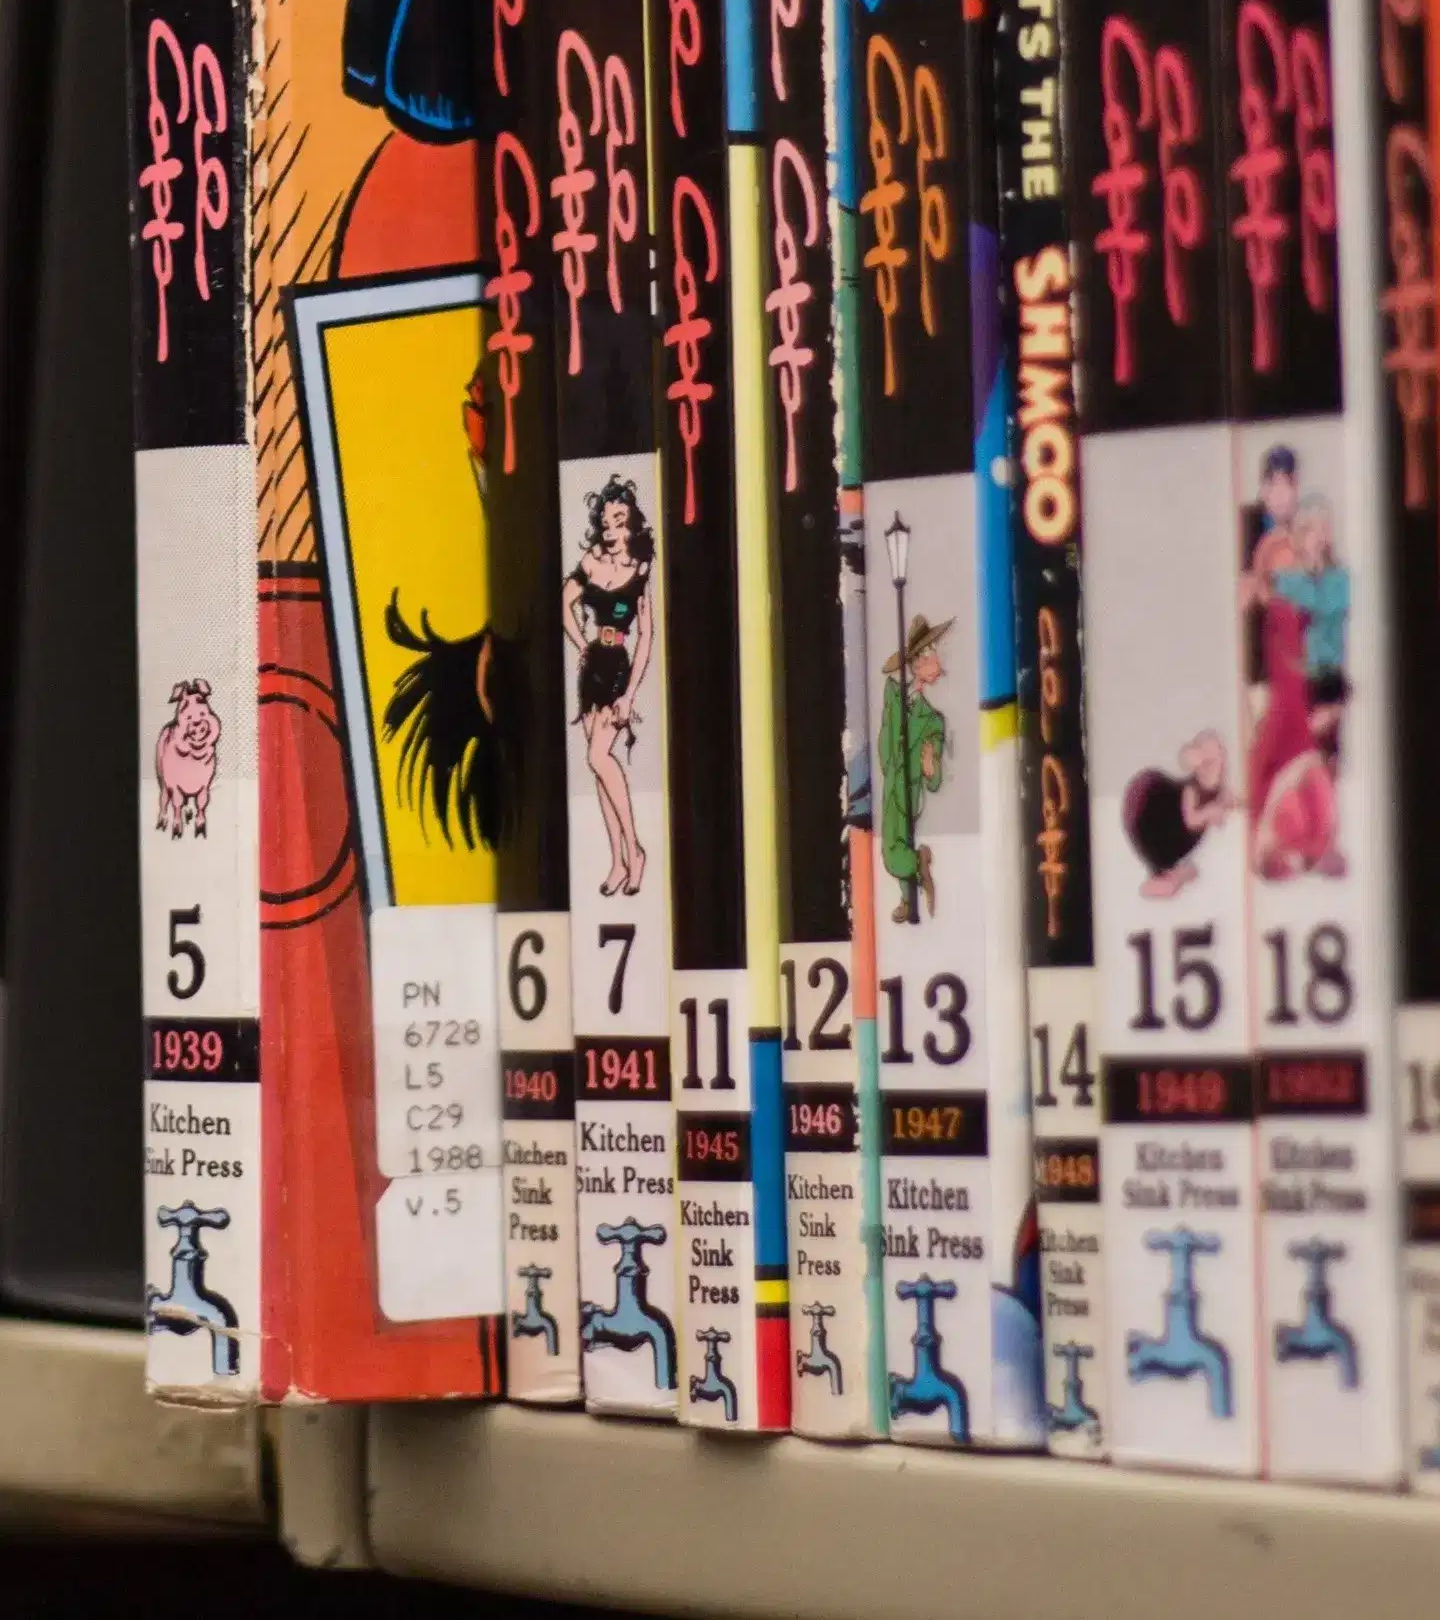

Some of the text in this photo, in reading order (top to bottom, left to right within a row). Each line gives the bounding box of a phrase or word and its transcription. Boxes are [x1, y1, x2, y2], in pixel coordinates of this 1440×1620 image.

[1019, 77, 1057, 201] THE
[1014, 243, 1077, 546] SHMOO
[166, 902, 206, 1001] 5
[507, 928, 548, 1022] 6
[598, 922, 637, 1016] 7
[1126, 921, 1223, 1032] 15
[1263, 923, 1354, 1028] 18
[403, 981, 441, 1009] PN
[780, 956, 852, 1052] 12
[404, 1020, 481, 1048] 6728
[880, 972, 972, 1067] 13
[150, 1029, 223, 1072] 1939
[678, 996, 737, 1090] 11
[404, 1062, 445, 1091] L5
[585, 1048, 658, 1090] 1941
[1032, 1022, 1095, 1108] 14
[504, 1068, 557, 1103] 1940
[149, 1102, 232, 1136] Kitchen
[406, 1103, 465, 1131] C29
[789, 1103, 843, 1136] 1946
[892, 1106, 962, 1140] 1947
[502, 1138, 568, 1168] Kitchen
[580, 1121, 666, 1153] Kitchen
[683, 1129, 740, 1162] 1945
[181, 1148, 244, 1178] Press
[408, 1146, 484, 1175] 1988
[1134, 1141, 1225, 1173] Kitchen
[511, 1176, 553, 1207] Sink
[576, 1166, 675, 1195] Sink Press
[788, 1172, 854, 1201] Kitchen
[887, 1177, 970, 1211] Kitchen
[1122, 1179, 1240, 1210] Sink Press
[508, 1213, 559, 1243] Press
[680, 1199, 750, 1227] Kitchen
[799, 1211, 836, 1239] Sink
[691, 1237, 734, 1267] Sink
[926, 1226, 984, 1260] Press
[796, 1248, 842, 1277] Press
[688, 1275, 740, 1304] Press
